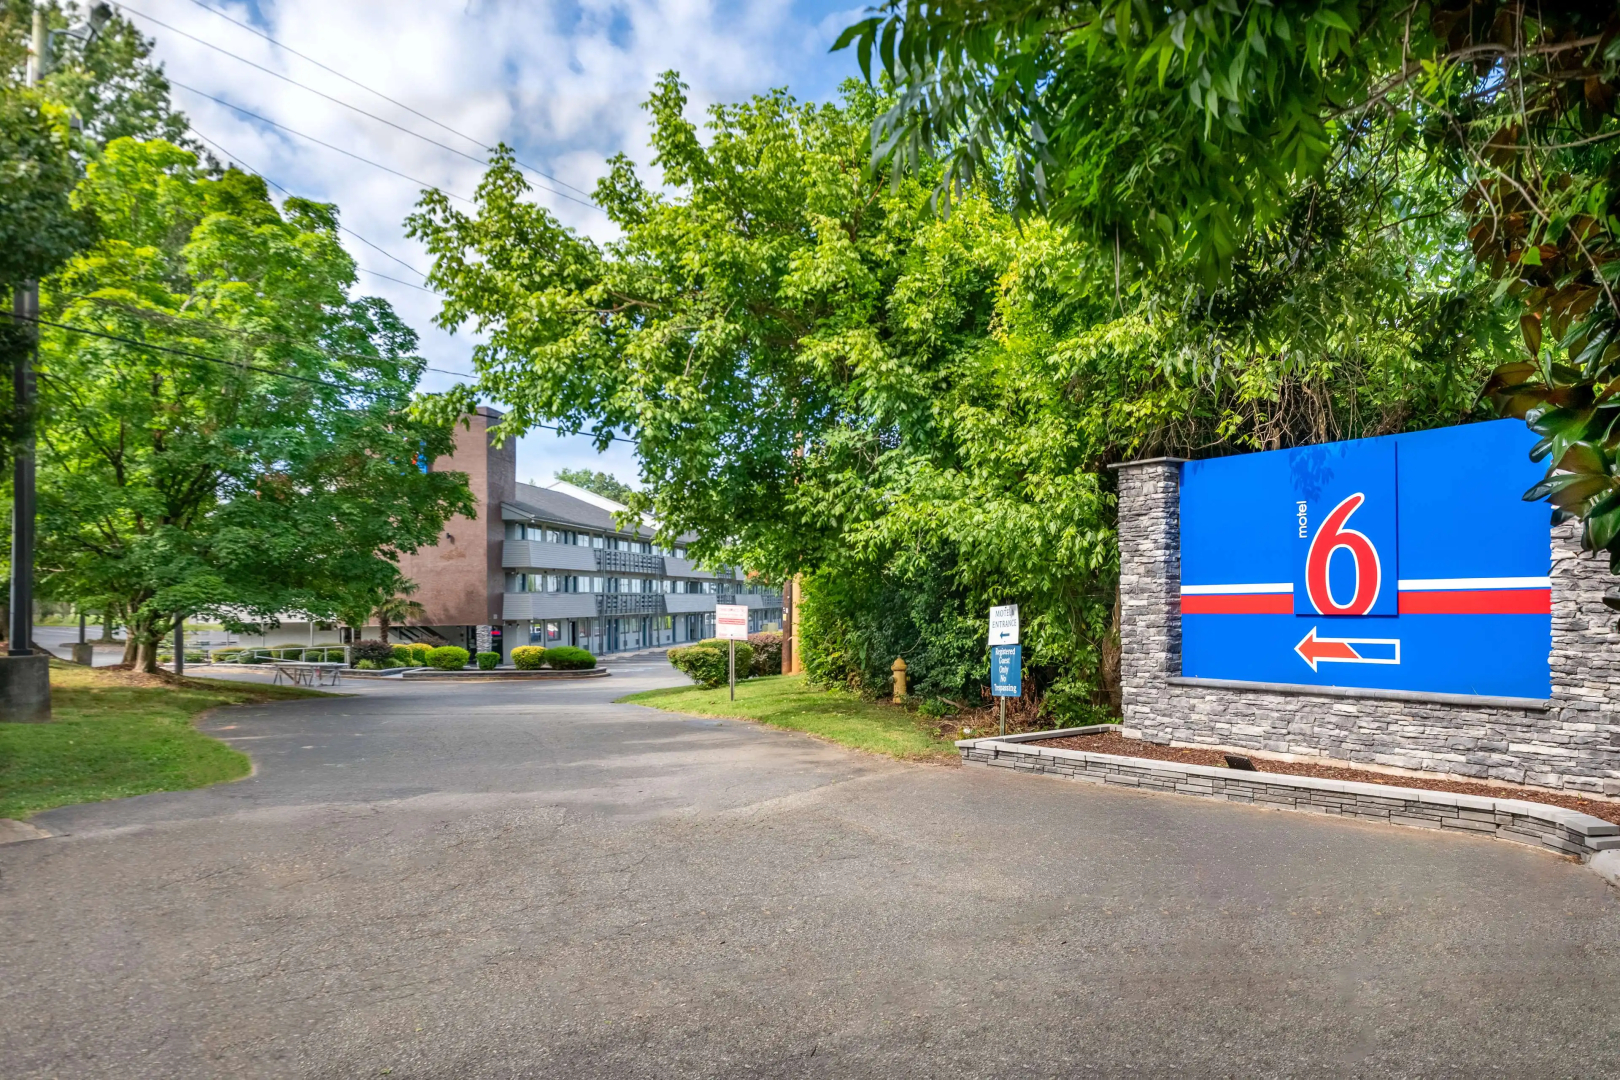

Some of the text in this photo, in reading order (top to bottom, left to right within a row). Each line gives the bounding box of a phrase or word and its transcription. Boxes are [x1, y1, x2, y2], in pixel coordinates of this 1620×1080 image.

[1296, 501, 1307, 538] motel
[1305, 492, 1381, 615] 6
[992, 619, 1017, 628] ENTRANCE
[995, 648, 1015, 656] Registered
[999, 666, 1009, 675] Only
[994, 684, 1017, 693] Trespassing
